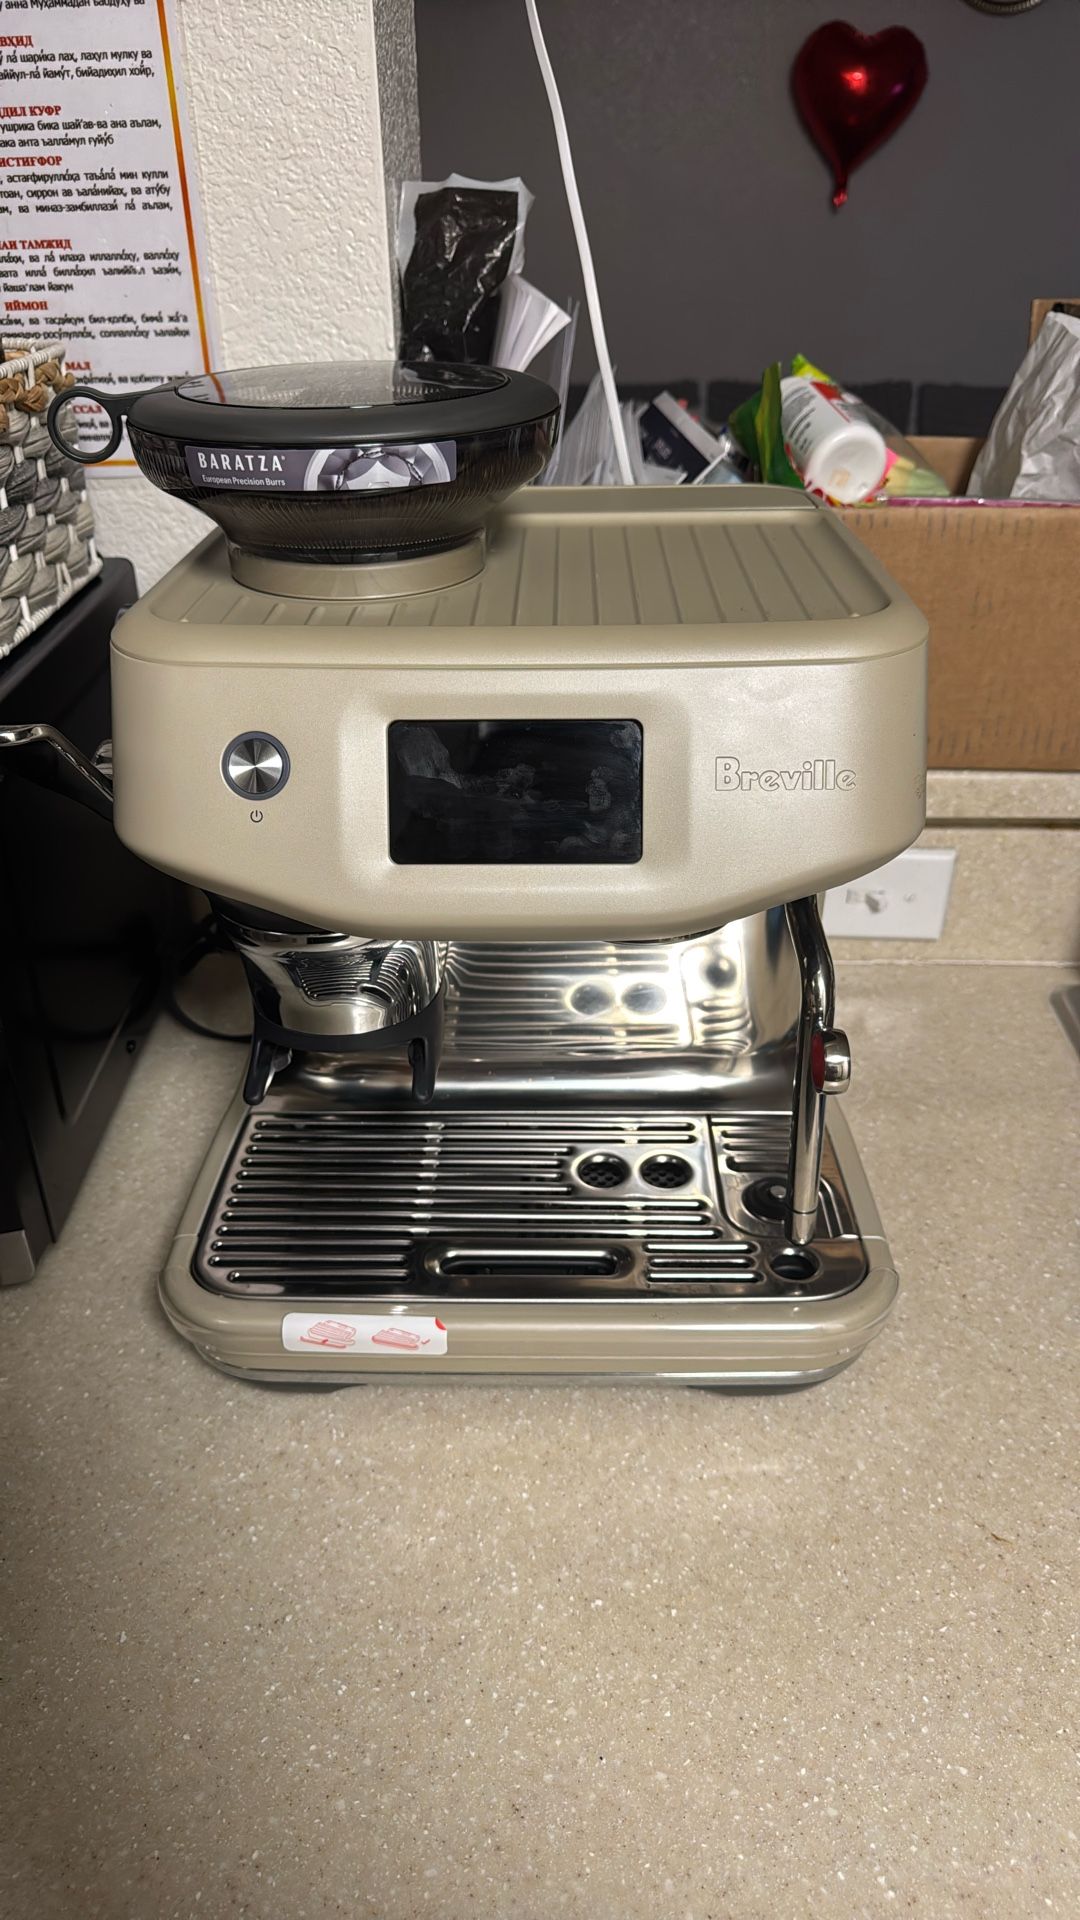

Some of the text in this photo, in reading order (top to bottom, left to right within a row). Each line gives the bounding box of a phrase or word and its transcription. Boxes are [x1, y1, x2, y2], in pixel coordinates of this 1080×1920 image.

[110, 50, 138, 62] мулку
[141, 50, 153, 59] ва
[29, 105, 62, 116] КУФР
[37, 120, 60, 131] бика
[110, 119, 127, 128] ана
[18, 138, 40, 147] анта
[119, 171, 138, 180] мин
[141, 170, 169, 181] кулли
[26, 188, 59, 200] сиррон
[62, 188, 73, 197] ав
[130, 186, 142, 195] ва
[18, 205, 30, 214] ва
[19, 238, 73, 251] ТАМЖИД
[29, 254, 40, 262] ва
[4, 299, 48, 311] ИЙМОН
[198, 452, 283, 472] BARATZA
[202, 474, 286, 487] European Precision Burrs
[715, 756, 857, 791] Breville
